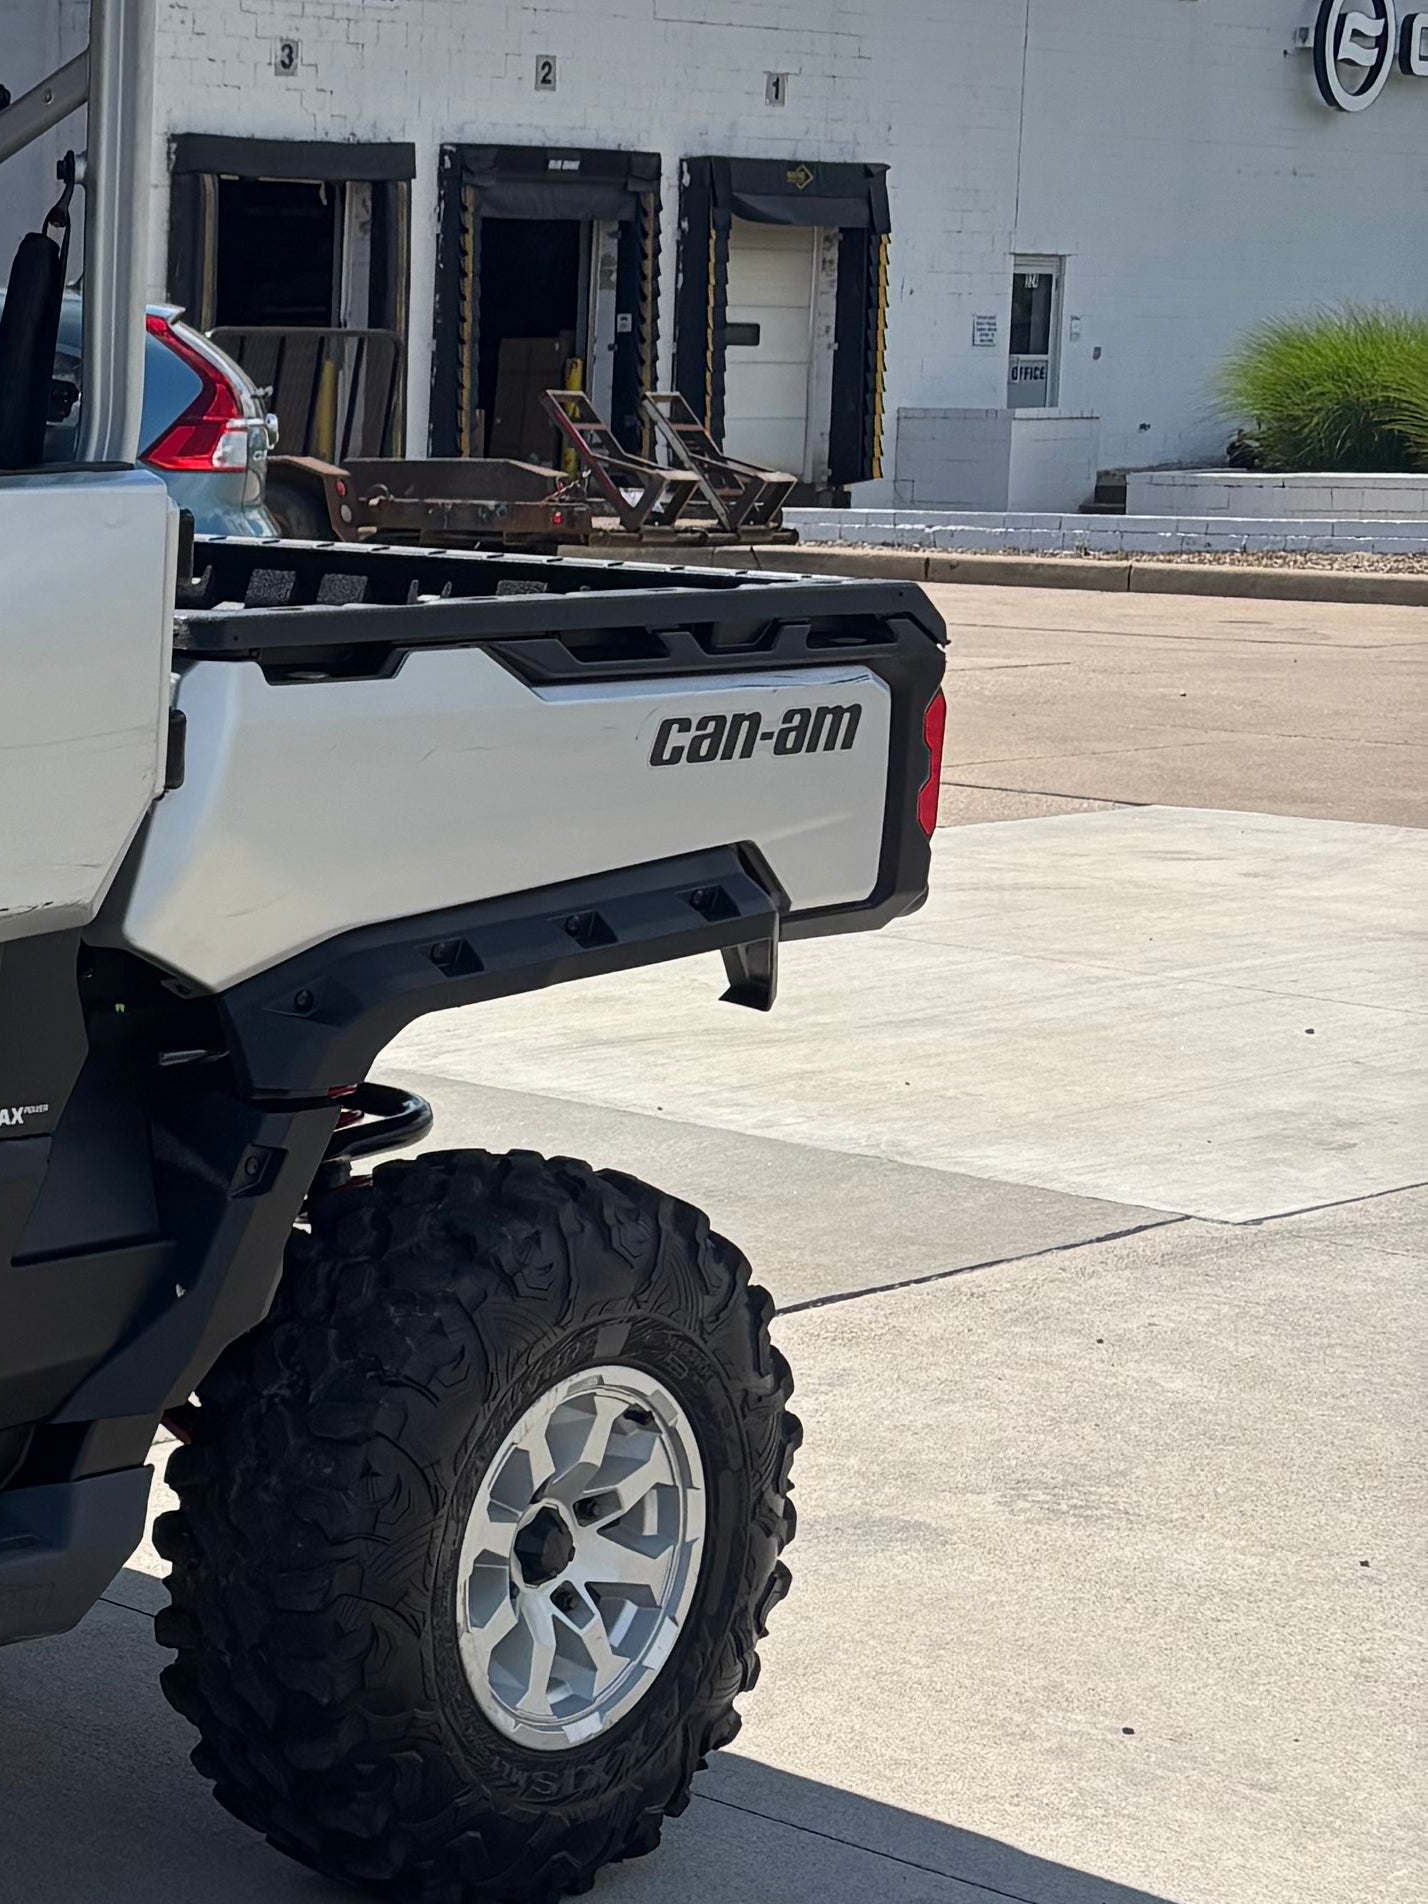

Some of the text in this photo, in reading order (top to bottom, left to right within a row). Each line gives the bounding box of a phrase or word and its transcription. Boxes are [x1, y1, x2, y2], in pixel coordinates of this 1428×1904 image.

[280, 43, 294, 70] 3
[541, 61, 552, 84] 2
[772, 76, 780, 100] 1
[1011, 366, 1046, 381] OFFICE
[649, 703, 862, 766] can-am
